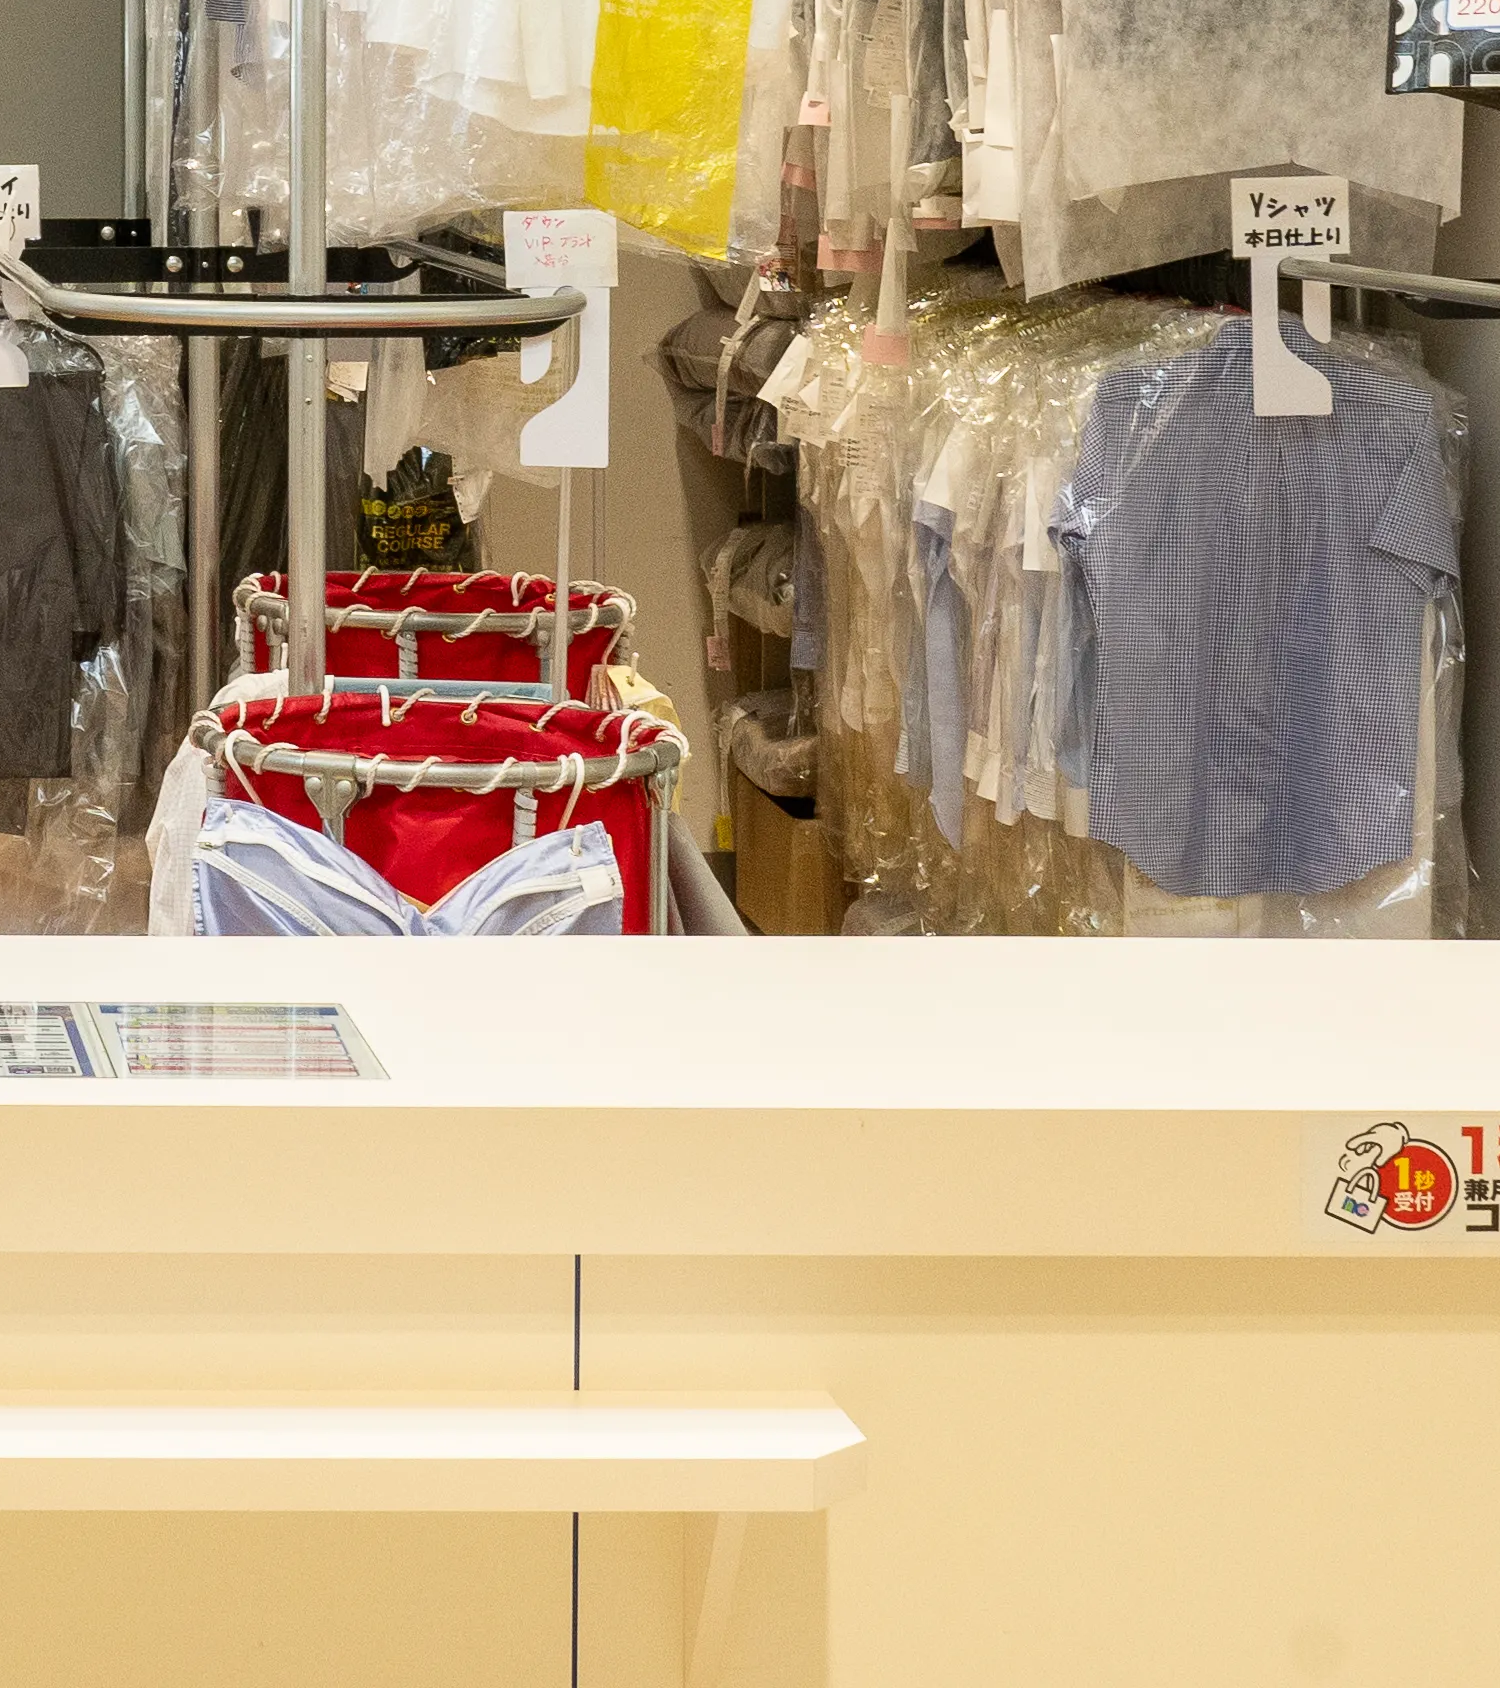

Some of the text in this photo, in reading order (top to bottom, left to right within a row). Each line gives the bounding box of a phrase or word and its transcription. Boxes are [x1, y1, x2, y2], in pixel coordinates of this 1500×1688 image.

[1250, 192, 1336, 218] Yシャツ
[1244, 227, 1340, 248] 本日仕上り
[1392, 1157, 1435, 1192] 1秒
[1393, 1192, 1435, 1213] 受付
